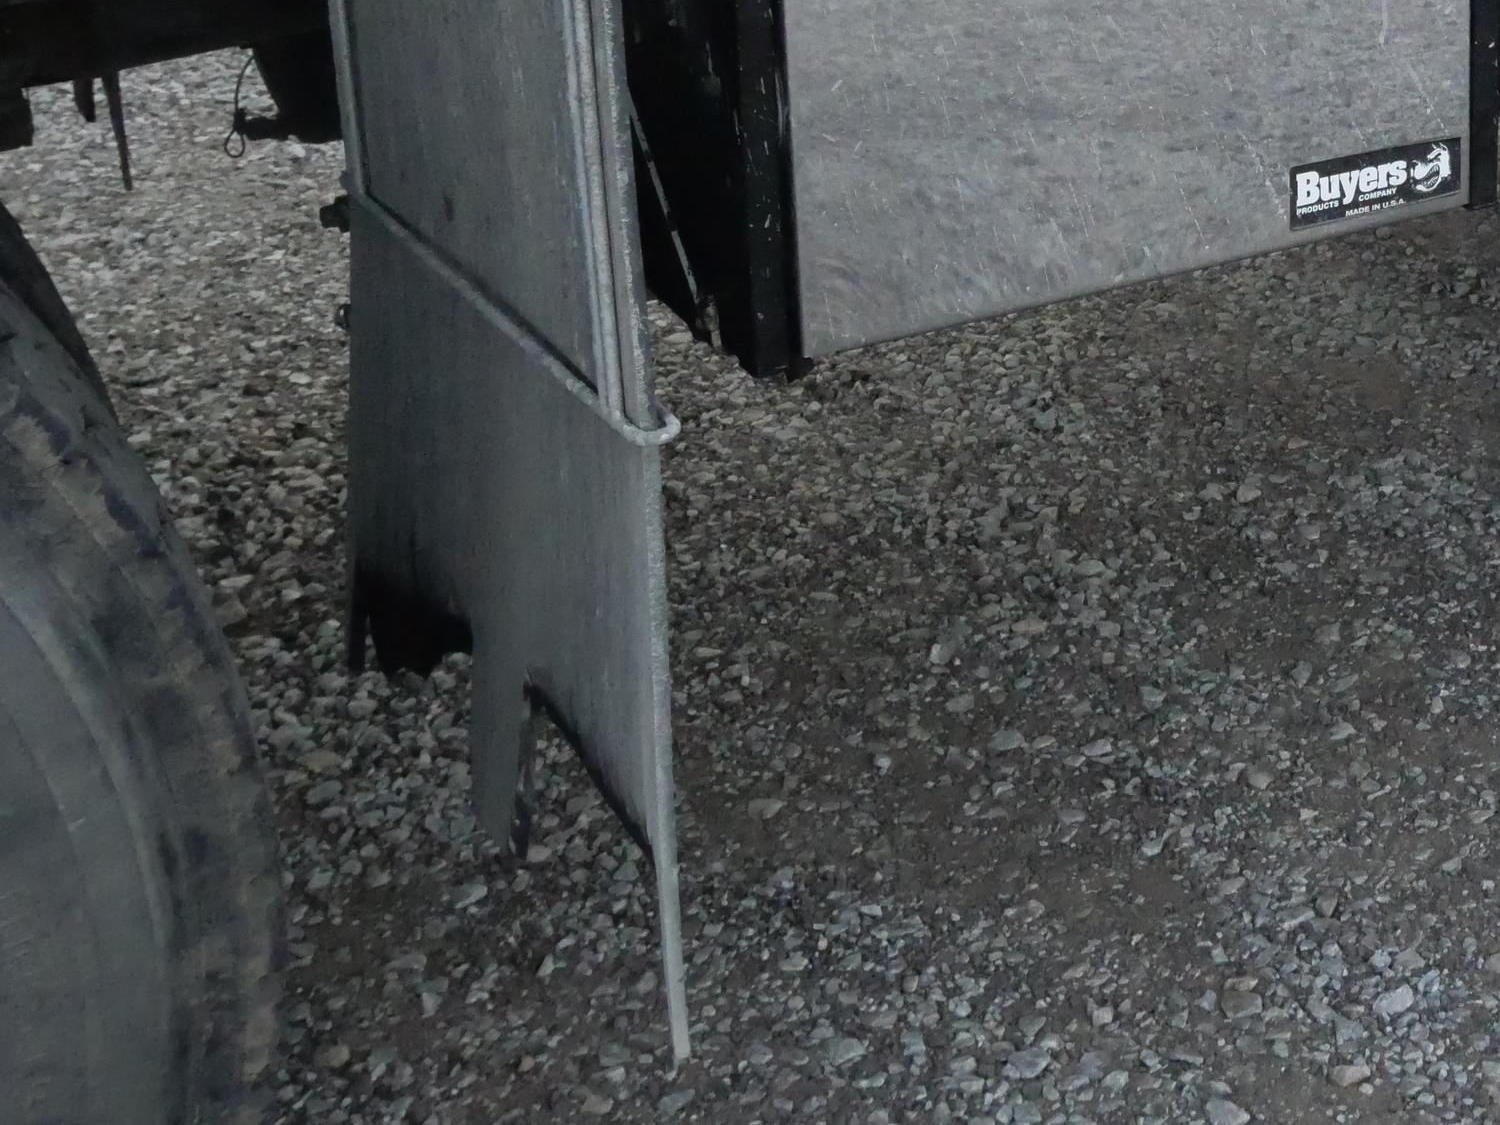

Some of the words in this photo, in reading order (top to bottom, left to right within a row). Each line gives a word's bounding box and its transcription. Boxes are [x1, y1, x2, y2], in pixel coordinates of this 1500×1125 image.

[1296, 160, 1408, 205] Buyers
[1296, 201, 1340, 216] PRODUCTS
[1358, 187, 1398, 202] COMPANY
[1345, 206, 1370, 217] MADE
[1371, 203, 1382, 211] IN
